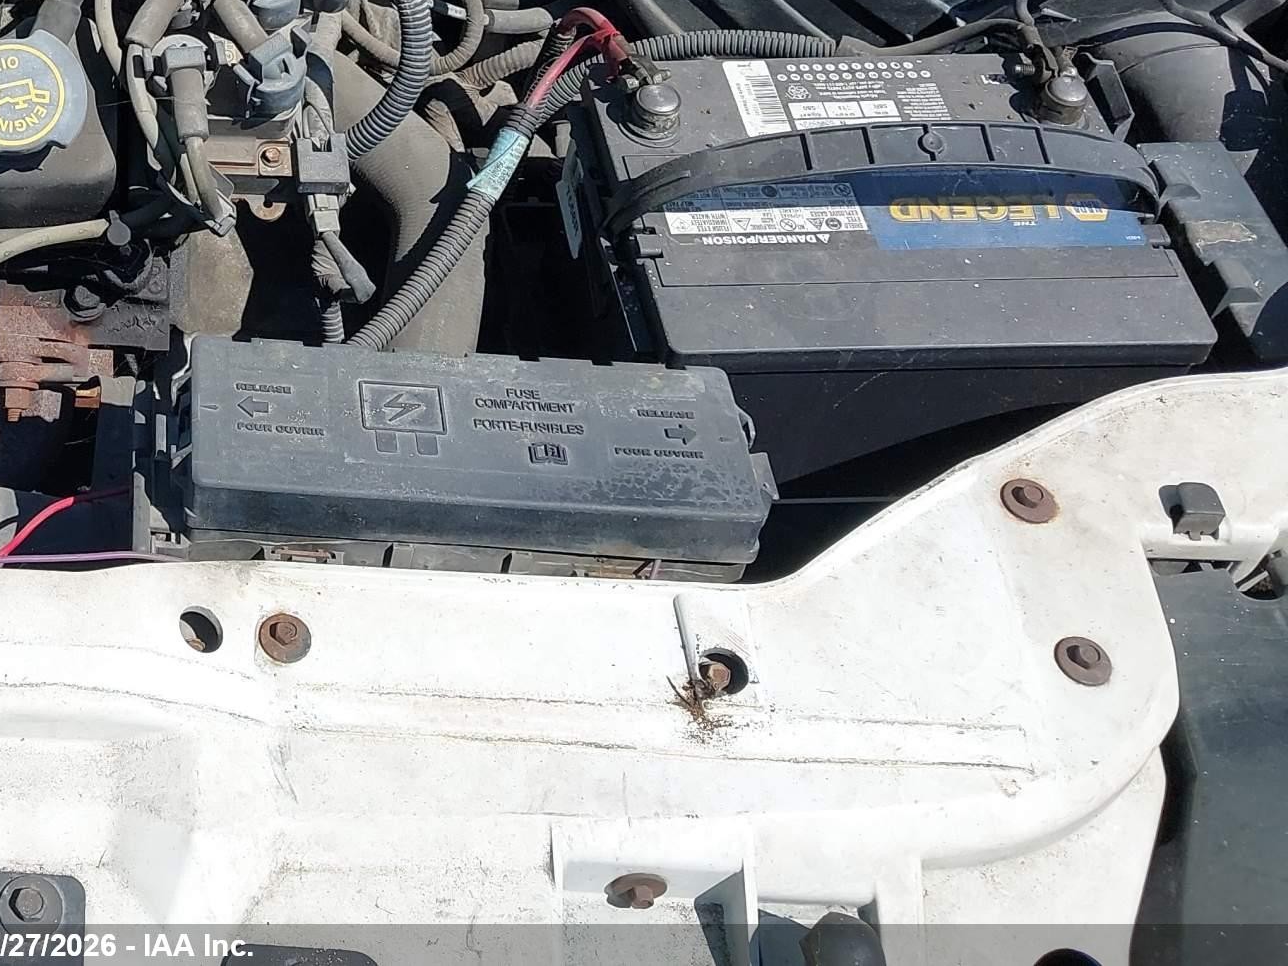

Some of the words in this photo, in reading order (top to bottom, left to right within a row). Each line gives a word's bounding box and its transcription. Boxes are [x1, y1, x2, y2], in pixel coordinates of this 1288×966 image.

[889, 194, 1062, 222] LEGEND
[703, 234, 816, 246] DANGER/POISON
[505, 387, 541, 400] FUSE
[474, 397, 576, 414] COMPARTMENT
[636, 408, 696, 420] RELEASE
[473, 418, 585, 436] PORTE-FUSIBLES
